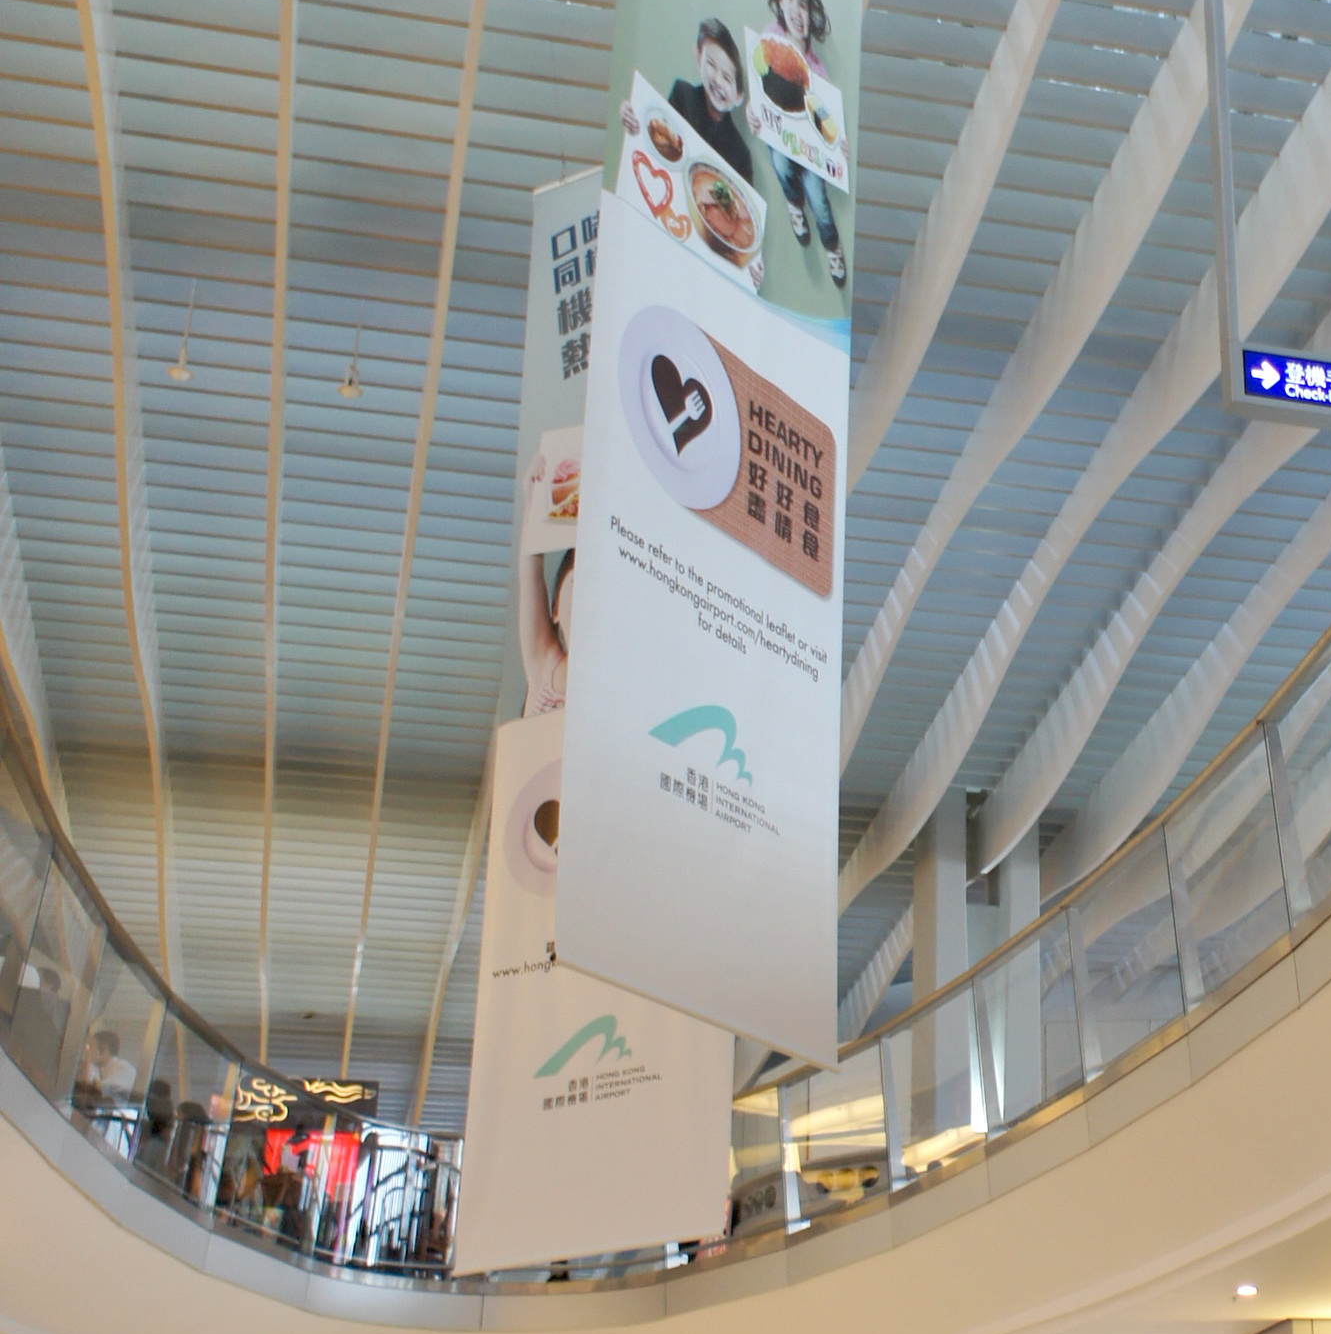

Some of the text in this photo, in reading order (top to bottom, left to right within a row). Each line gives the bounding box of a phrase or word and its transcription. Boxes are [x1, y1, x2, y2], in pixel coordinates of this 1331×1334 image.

[750, 400, 824, 468] HEARTY
[749, 429, 822, 499] DINING
[610, 515, 828, 665] Please refer to the promotional leaflet or visit
[618, 545, 819, 682] www.hongkongairport.com/heartydining
[697, 612, 747, 655] for details
[715, 809, 752, 833] AIRPORT
[716, 782, 766, 814] HONG KONG
[716, 796, 780, 836] INTERNATIONAL
